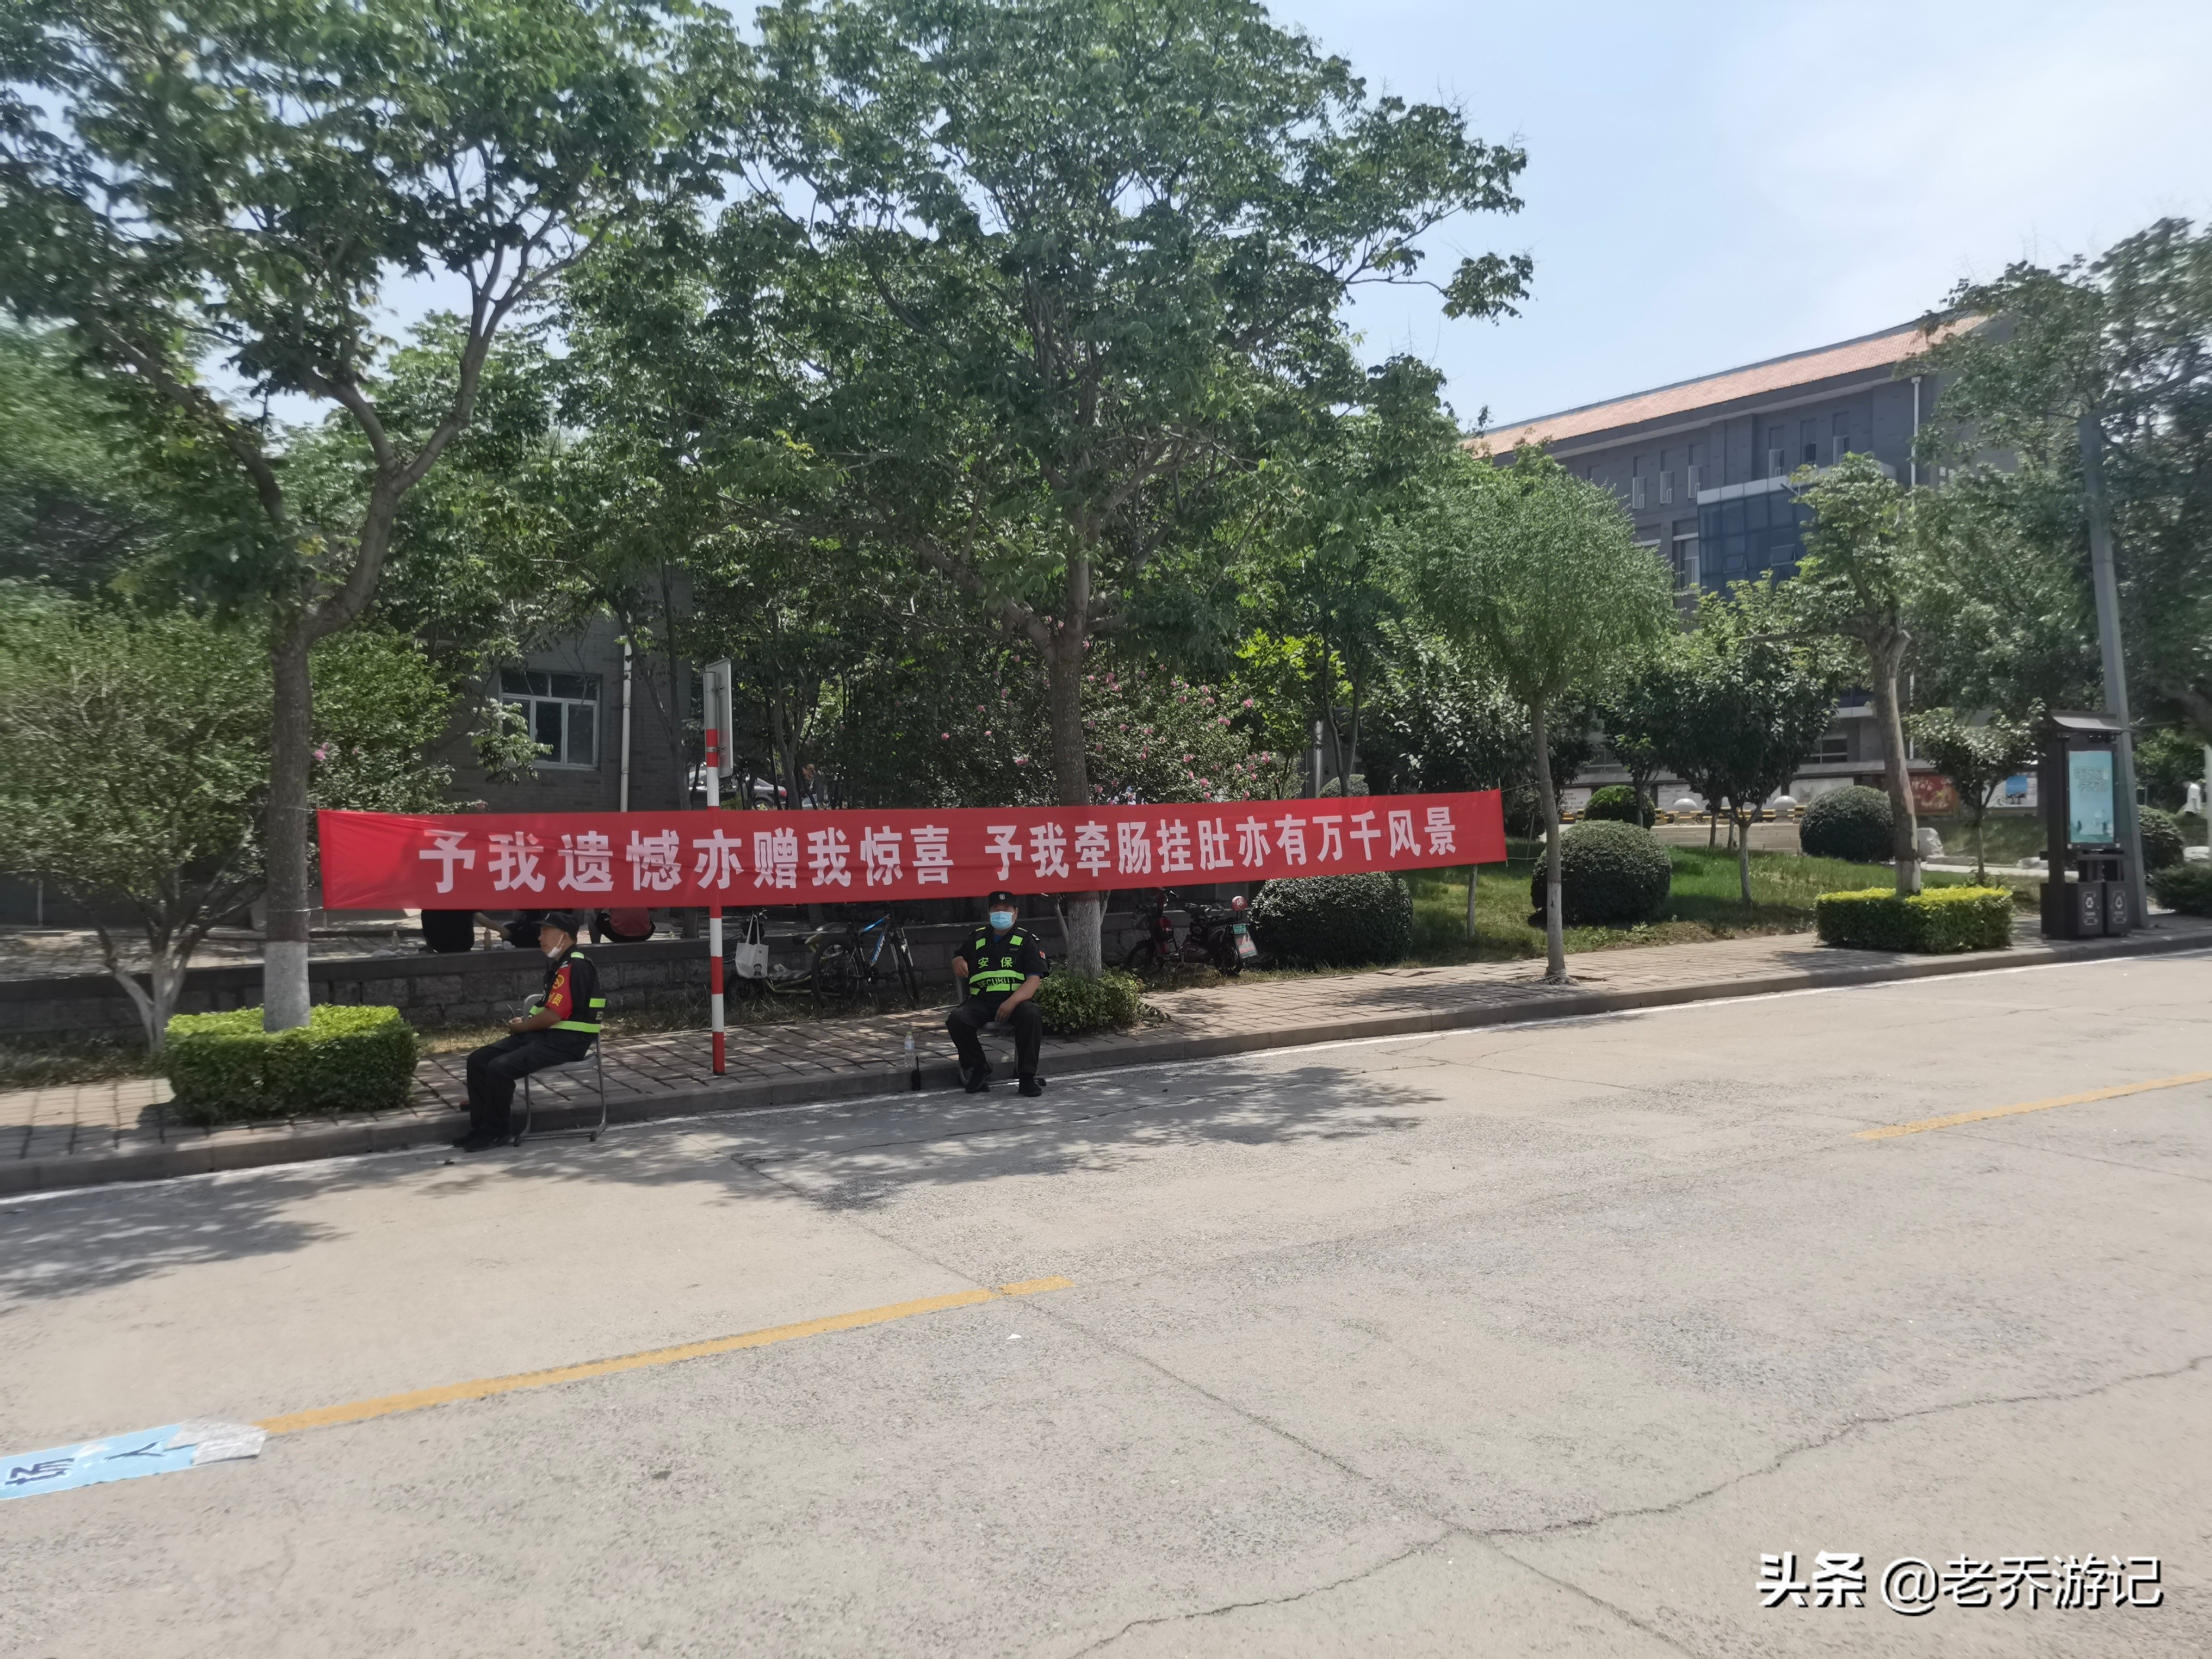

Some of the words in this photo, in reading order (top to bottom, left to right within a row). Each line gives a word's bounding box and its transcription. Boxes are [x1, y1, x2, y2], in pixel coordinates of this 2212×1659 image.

[419, 825, 954, 893] 予我遗憾亦赠我惊喜
[984, 807, 1457, 880] 予我牵肠挂肚亦有万千风景
